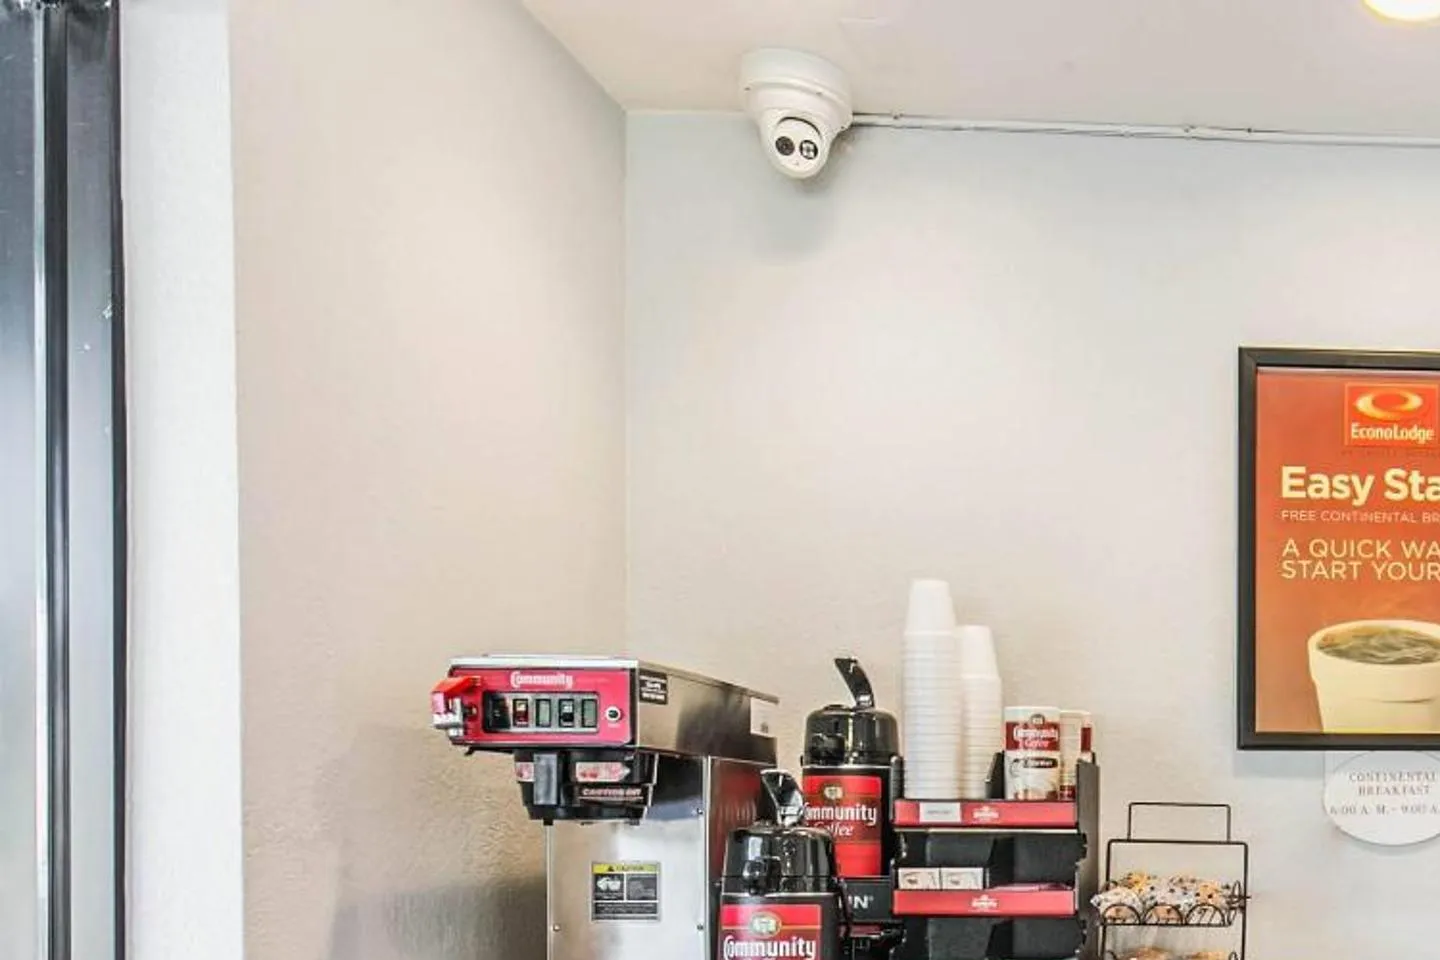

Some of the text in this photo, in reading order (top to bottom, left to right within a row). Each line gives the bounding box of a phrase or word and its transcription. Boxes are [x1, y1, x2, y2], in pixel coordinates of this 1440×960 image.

[1351, 423, 1434, 444] EconoLodge
[1281, 466, 1375, 506] Easy
[1281, 510, 1316, 521] FREE
[1321, 511, 1417, 524] CONTINENTAL
[1282, 538, 1300, 557] A
[1309, 538, 1392, 559] QUICK
[1281, 559, 1362, 579] START
[511, 671, 573, 688] Community
[1350, 771, 1437, 782] CONTINENTAL
[1358, 785, 1431, 797] BREAKFAST
